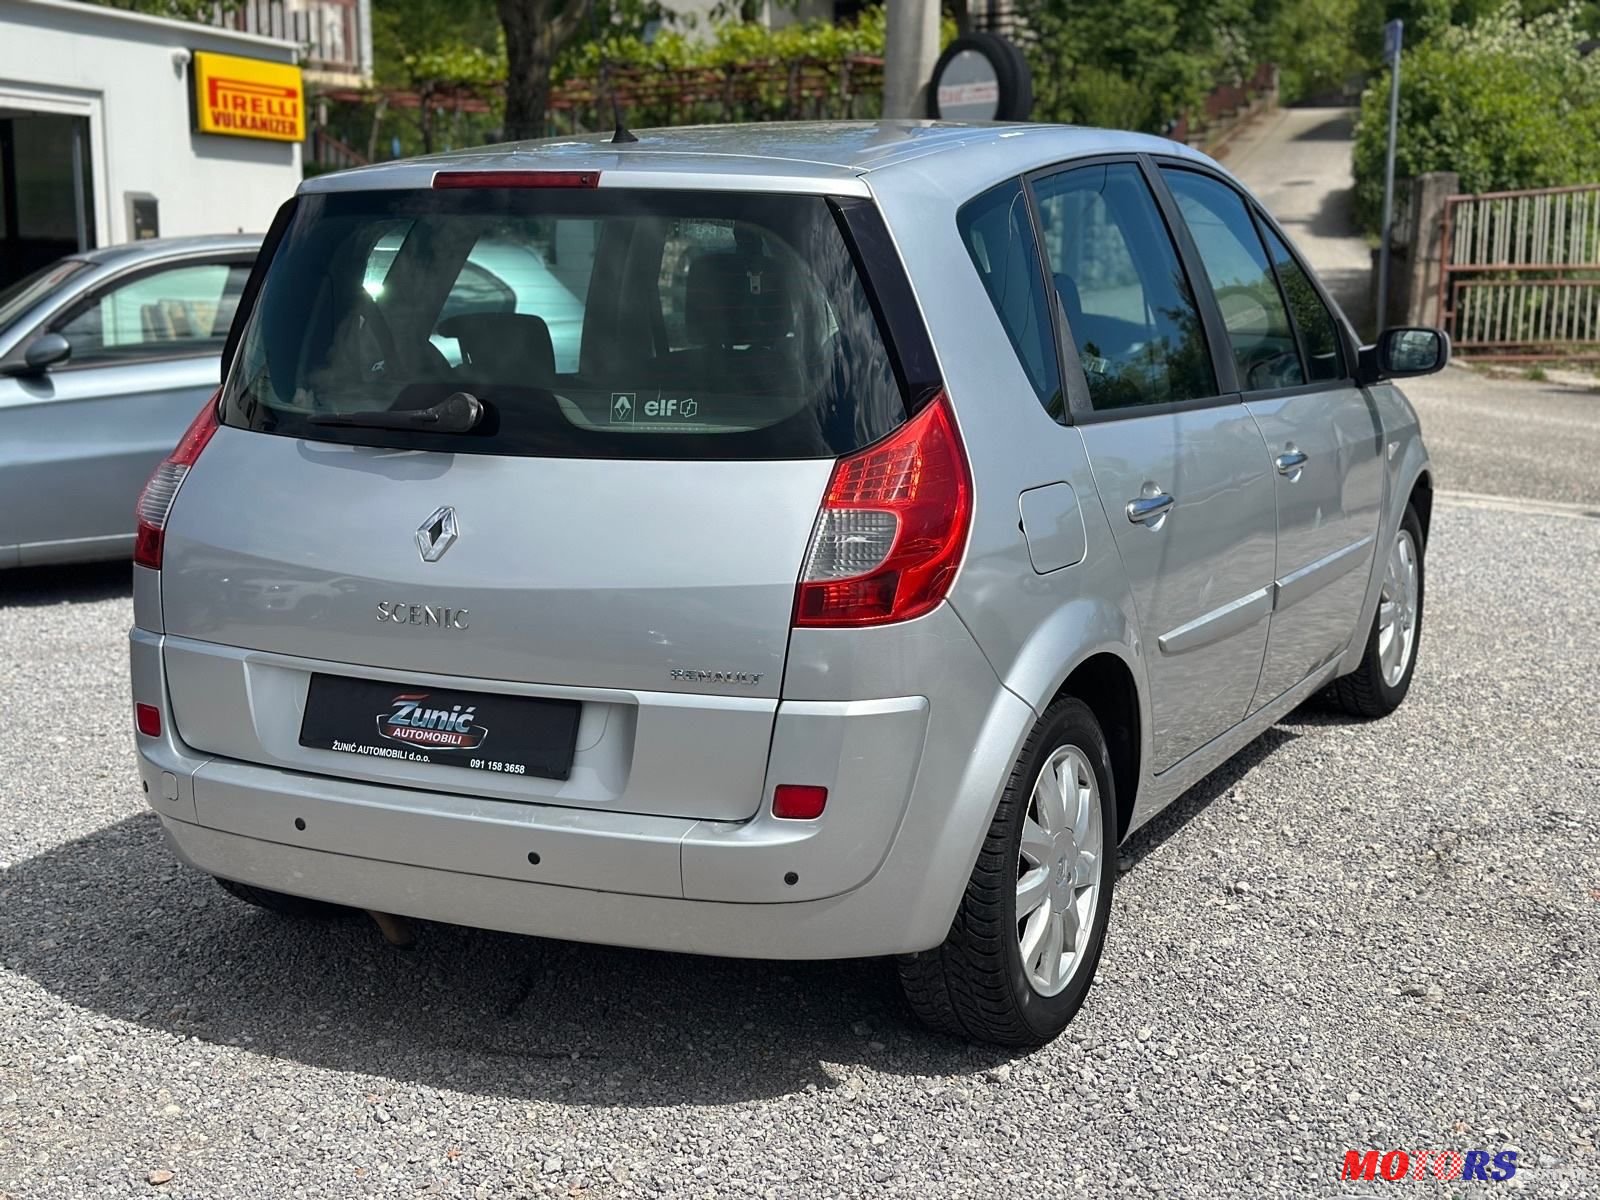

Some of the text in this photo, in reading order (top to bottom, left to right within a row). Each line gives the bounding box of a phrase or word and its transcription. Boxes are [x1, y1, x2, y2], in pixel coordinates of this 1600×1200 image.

[208, 76, 298, 118] PIRELLI
[212, 110, 298, 136] VULKANIZER
[644, 399, 677, 417] elf
[376, 601, 470, 630] SCENIC
[670, 669, 764, 685] RENAULT
[392, 727, 463, 745] AUTOMOBILI
[332, 740, 431, 763] ŽUNIĆ AUTOMOBILI d.o.o.
[470, 758, 525, 774] 091 158 3658
